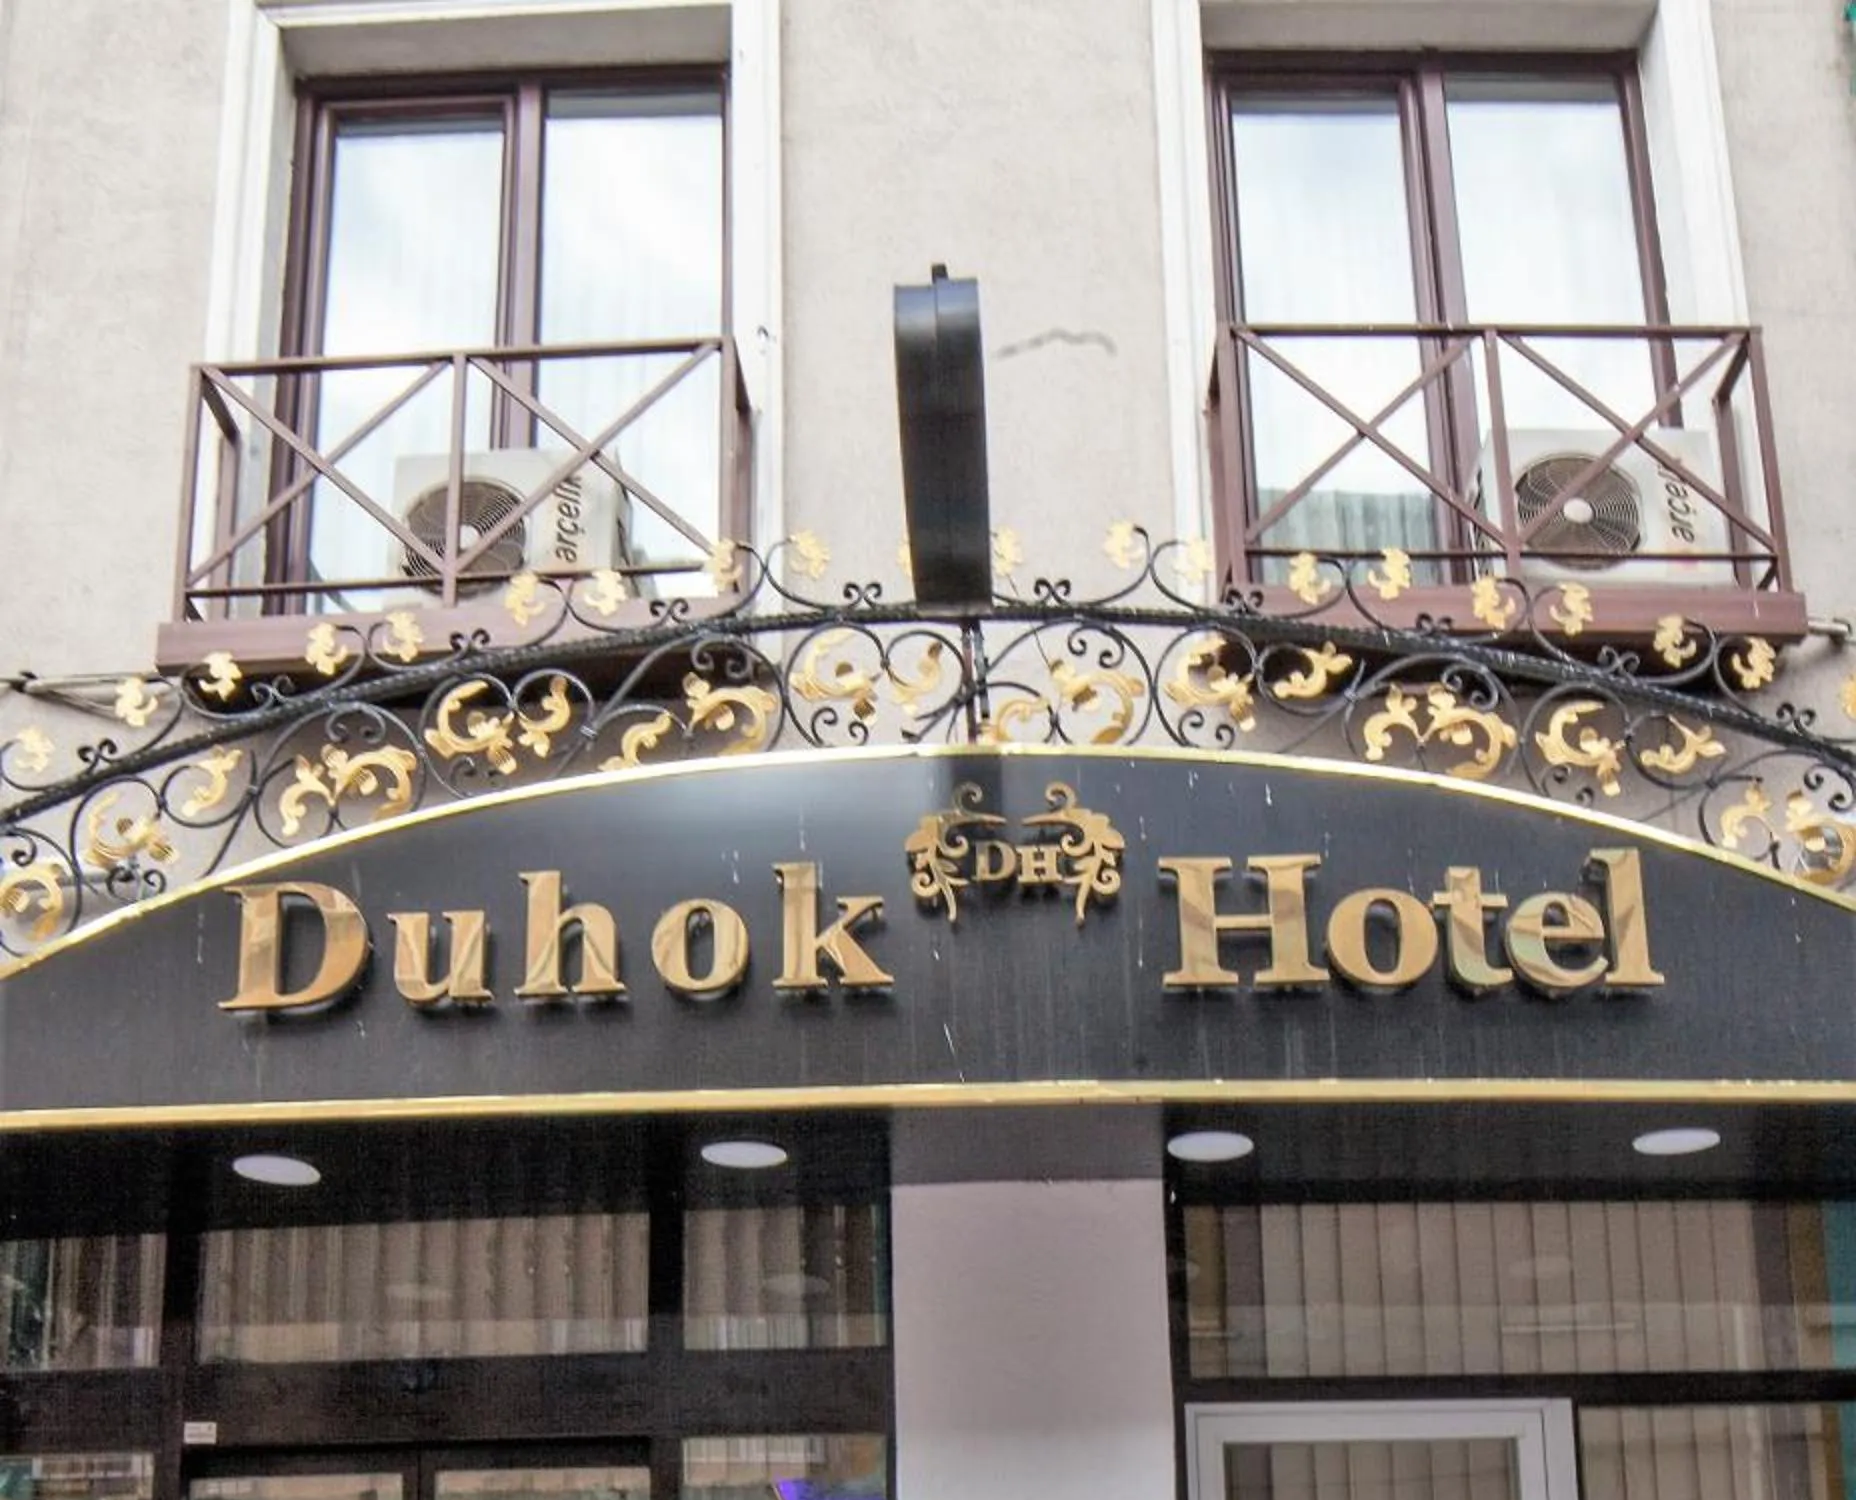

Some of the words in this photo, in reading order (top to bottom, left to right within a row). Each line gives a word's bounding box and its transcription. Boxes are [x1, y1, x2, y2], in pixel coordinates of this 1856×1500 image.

[1657, 459, 1697, 544] arçel
[971, 840, 1062, 883] DH
[217, 862, 894, 1012] Duhok
[1158, 848, 1664, 995] Hotel
